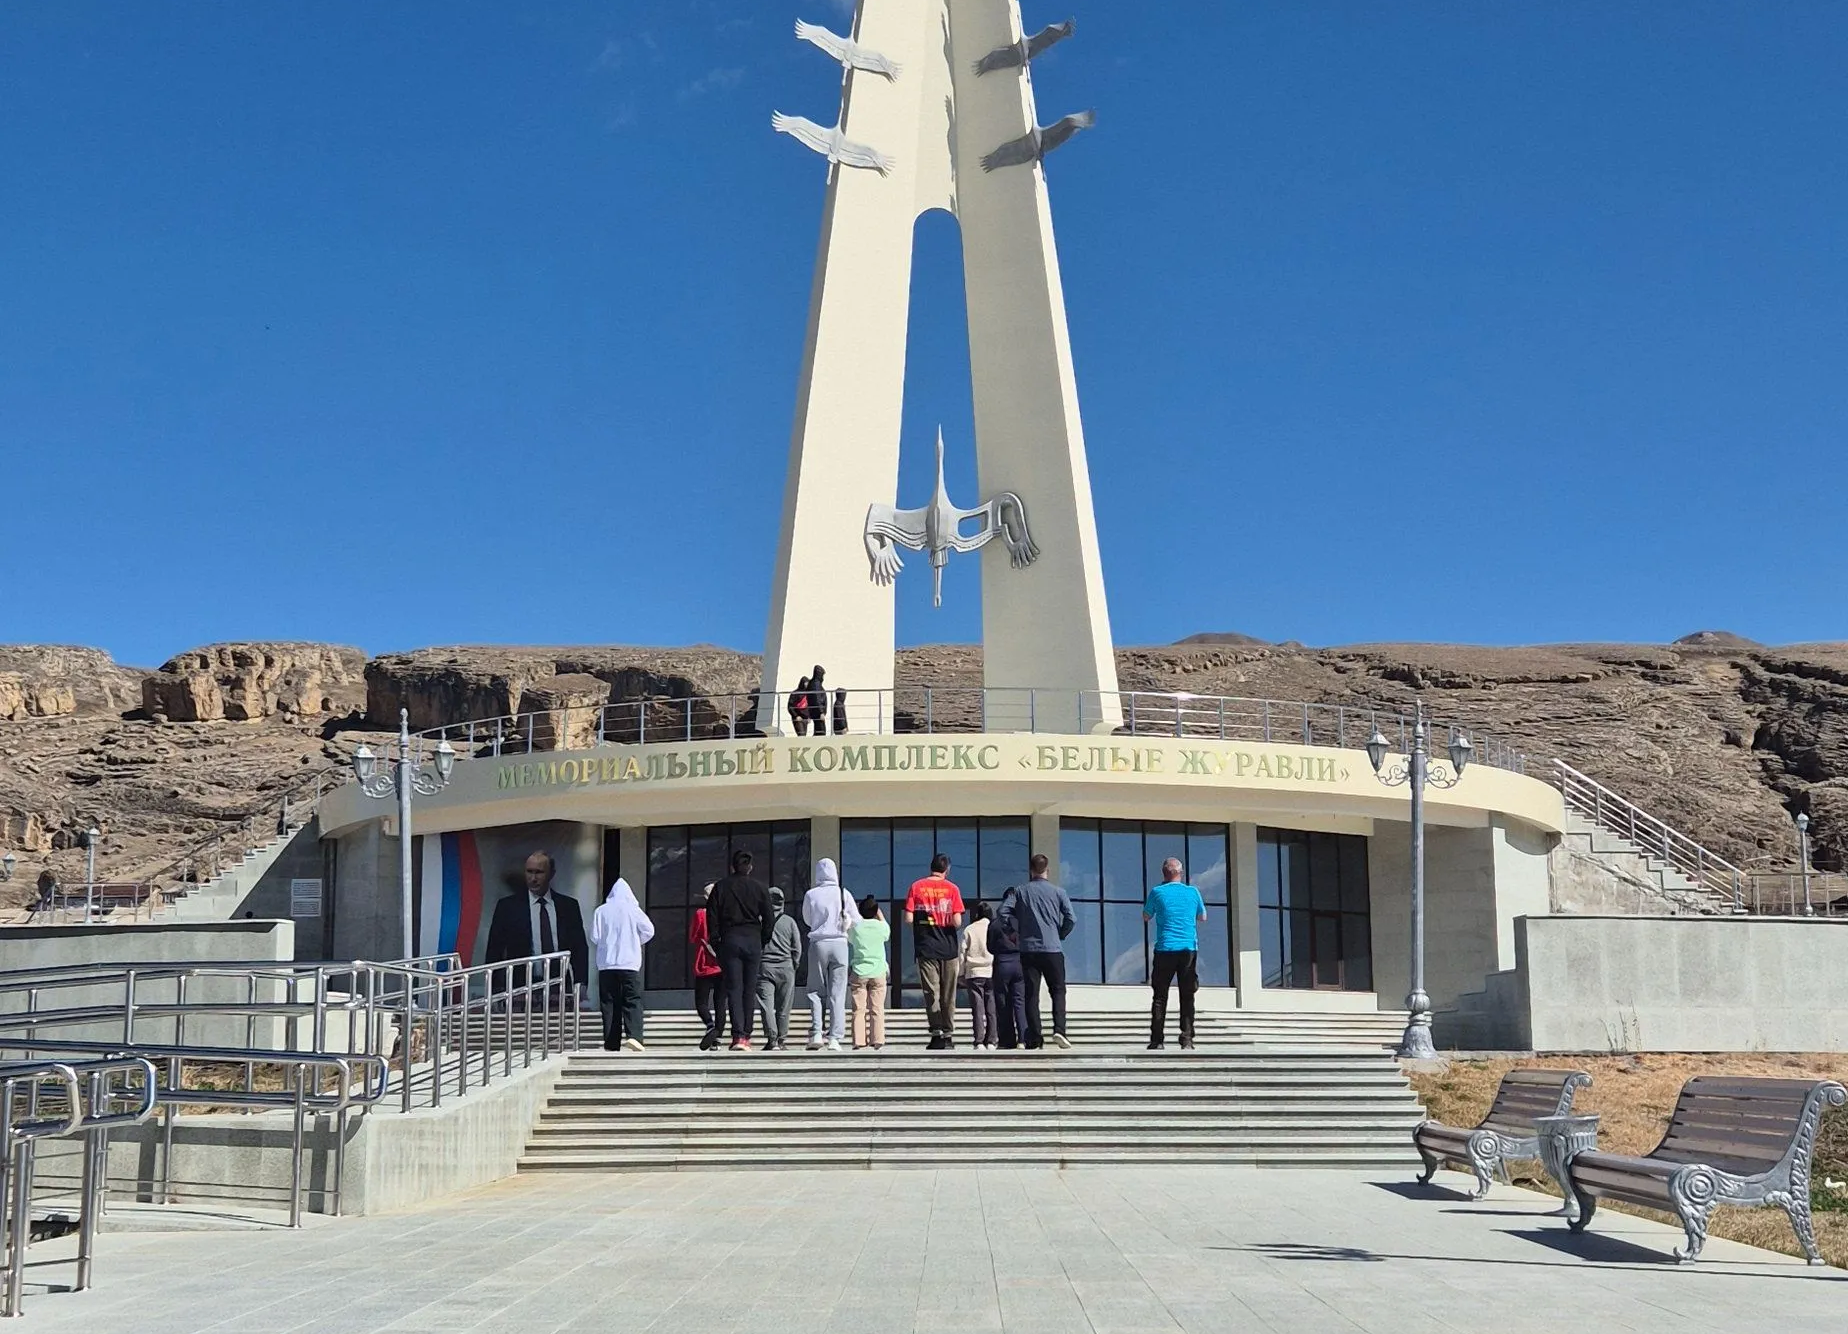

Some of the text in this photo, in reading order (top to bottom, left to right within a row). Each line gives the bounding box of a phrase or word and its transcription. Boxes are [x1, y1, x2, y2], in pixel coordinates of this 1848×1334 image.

[497, 742, 1351, 789] МЕМОРИАЛЬНЫЙ КОМПЛЕКС «БЕЛЫЕ ЖУРАВЛИ»
